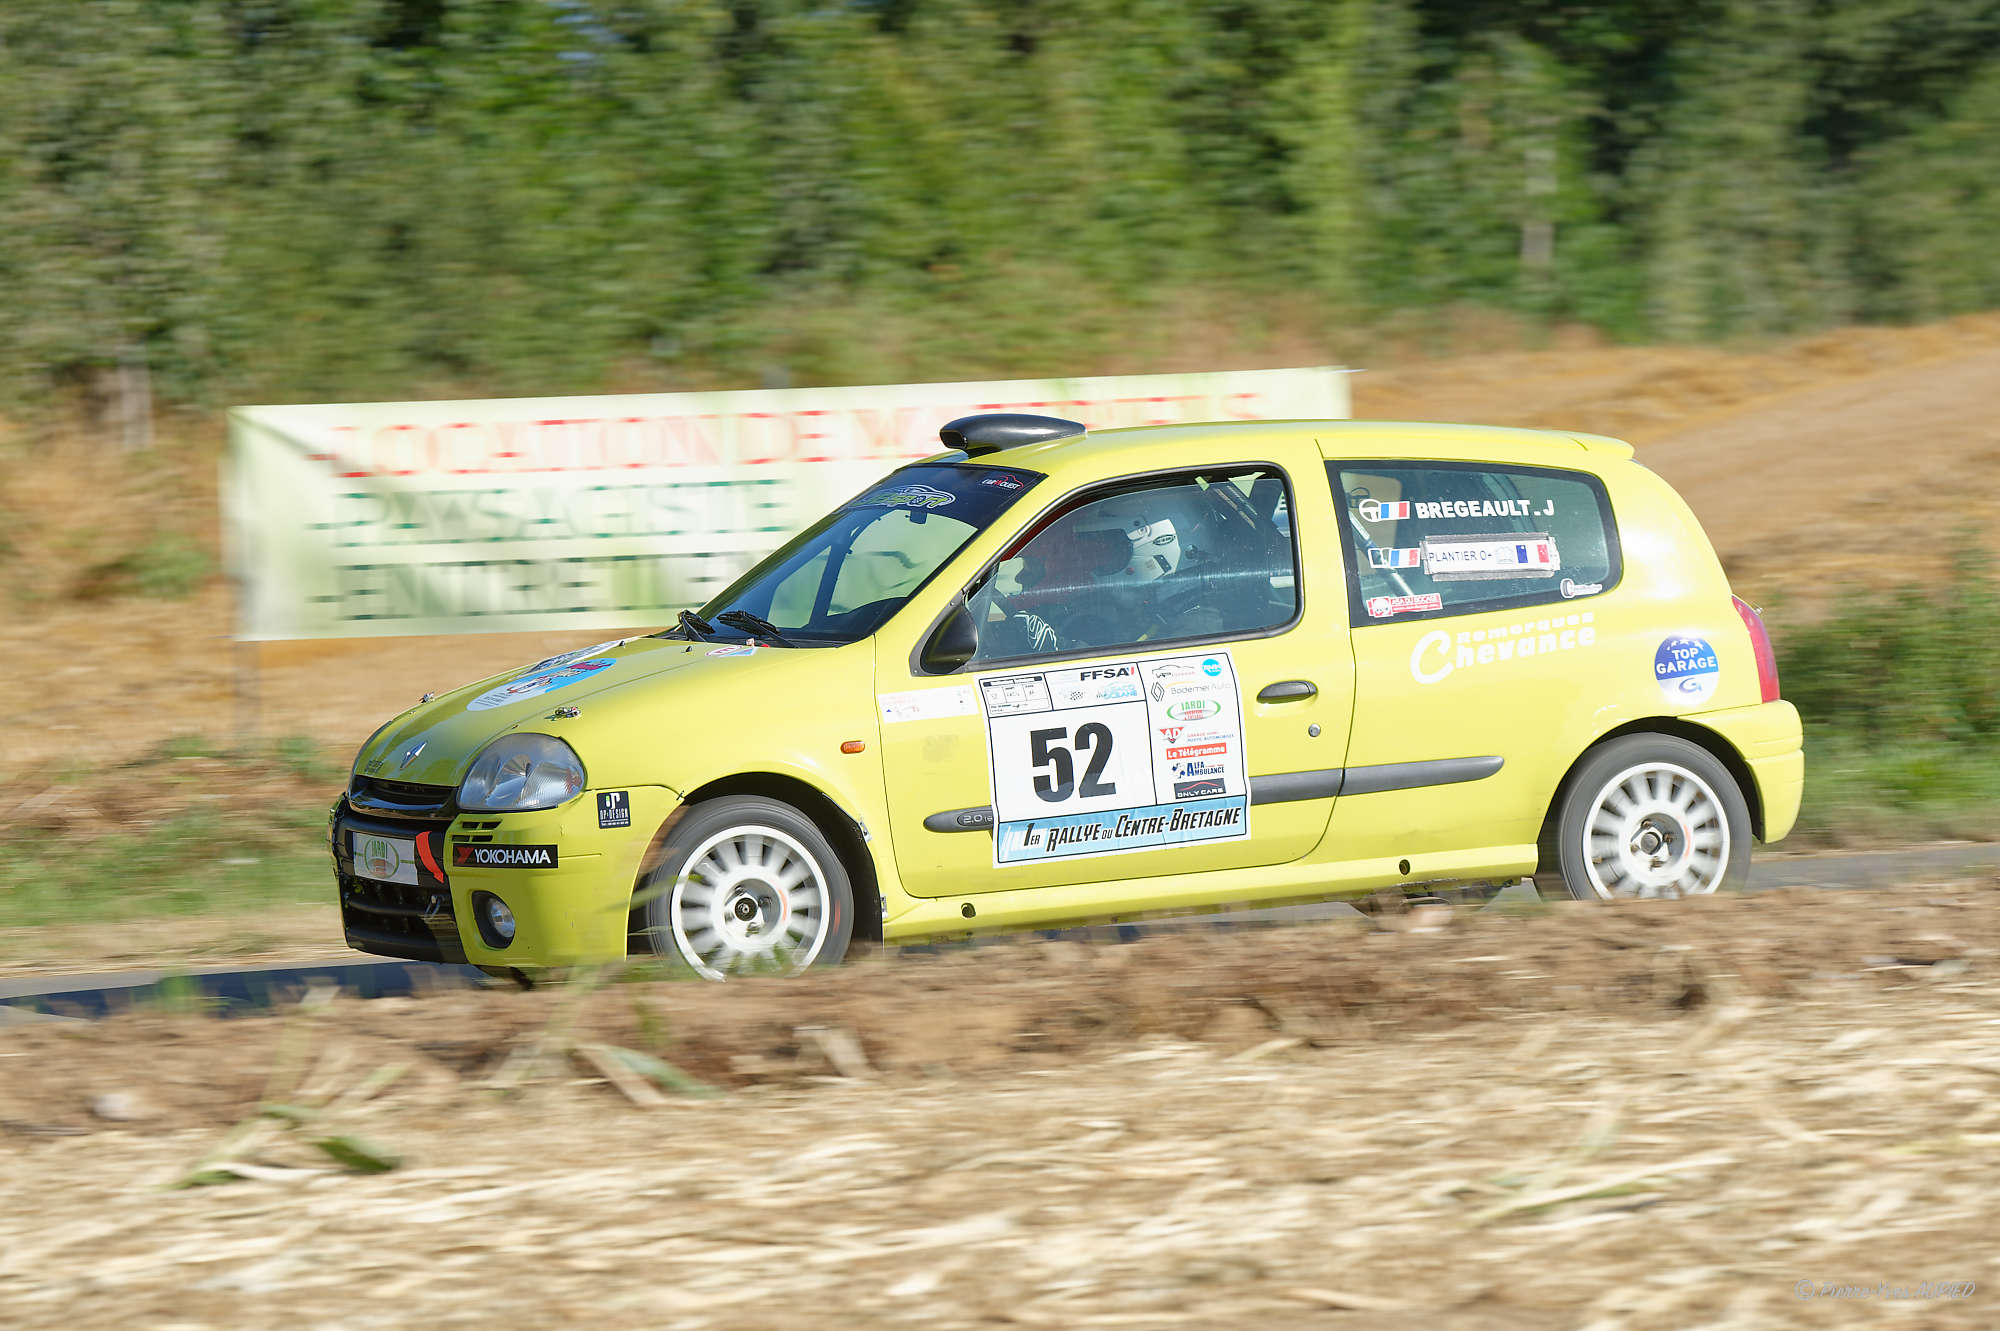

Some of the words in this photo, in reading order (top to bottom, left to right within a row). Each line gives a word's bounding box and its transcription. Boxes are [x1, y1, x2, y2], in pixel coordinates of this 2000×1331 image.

[1427, 550, 1478, 562] PLANTIER
[1410, 626, 1596, 685] Chevance
[1671, 647, 1699, 661] TOP
[1656, 655, 1717, 674] GARAGE
[1080, 667, 1130, 681] FFSA
[1029, 721, 1117, 803] 52
[1177, 790, 1200, 798] ONLY
[1046, 823, 1102, 852] RALLYE
[1114, 807, 1242, 839] CENTRE-BRETAGNE
[474, 848, 552, 864] YOKOHAMA
